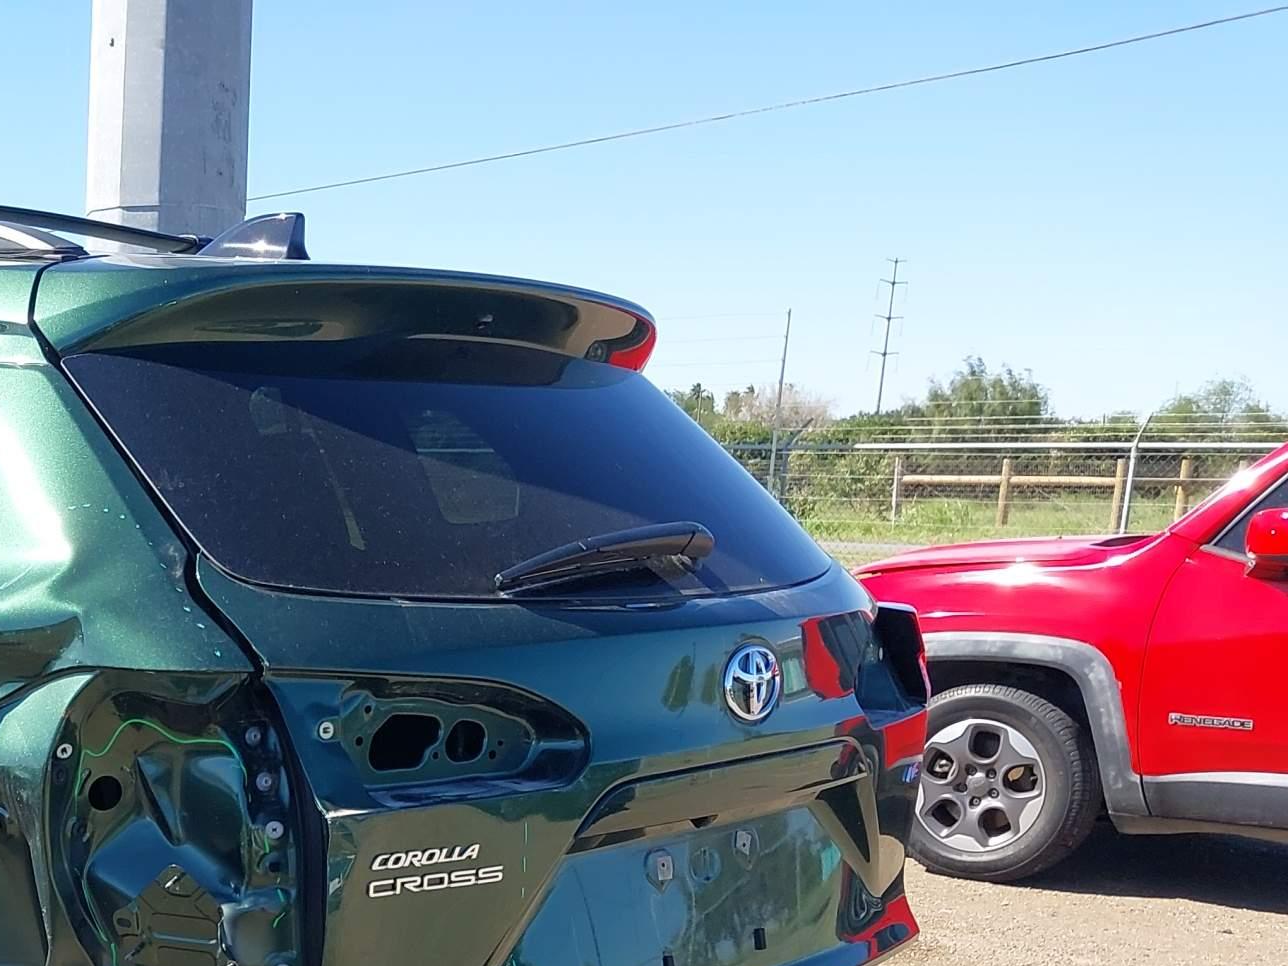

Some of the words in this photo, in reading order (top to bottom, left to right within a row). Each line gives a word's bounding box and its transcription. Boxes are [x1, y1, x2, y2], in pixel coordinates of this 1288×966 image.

[1168, 713, 1253, 730] RENEGADE
[371, 843, 480, 871] COROLLA
[368, 865, 504, 898] CROSS
